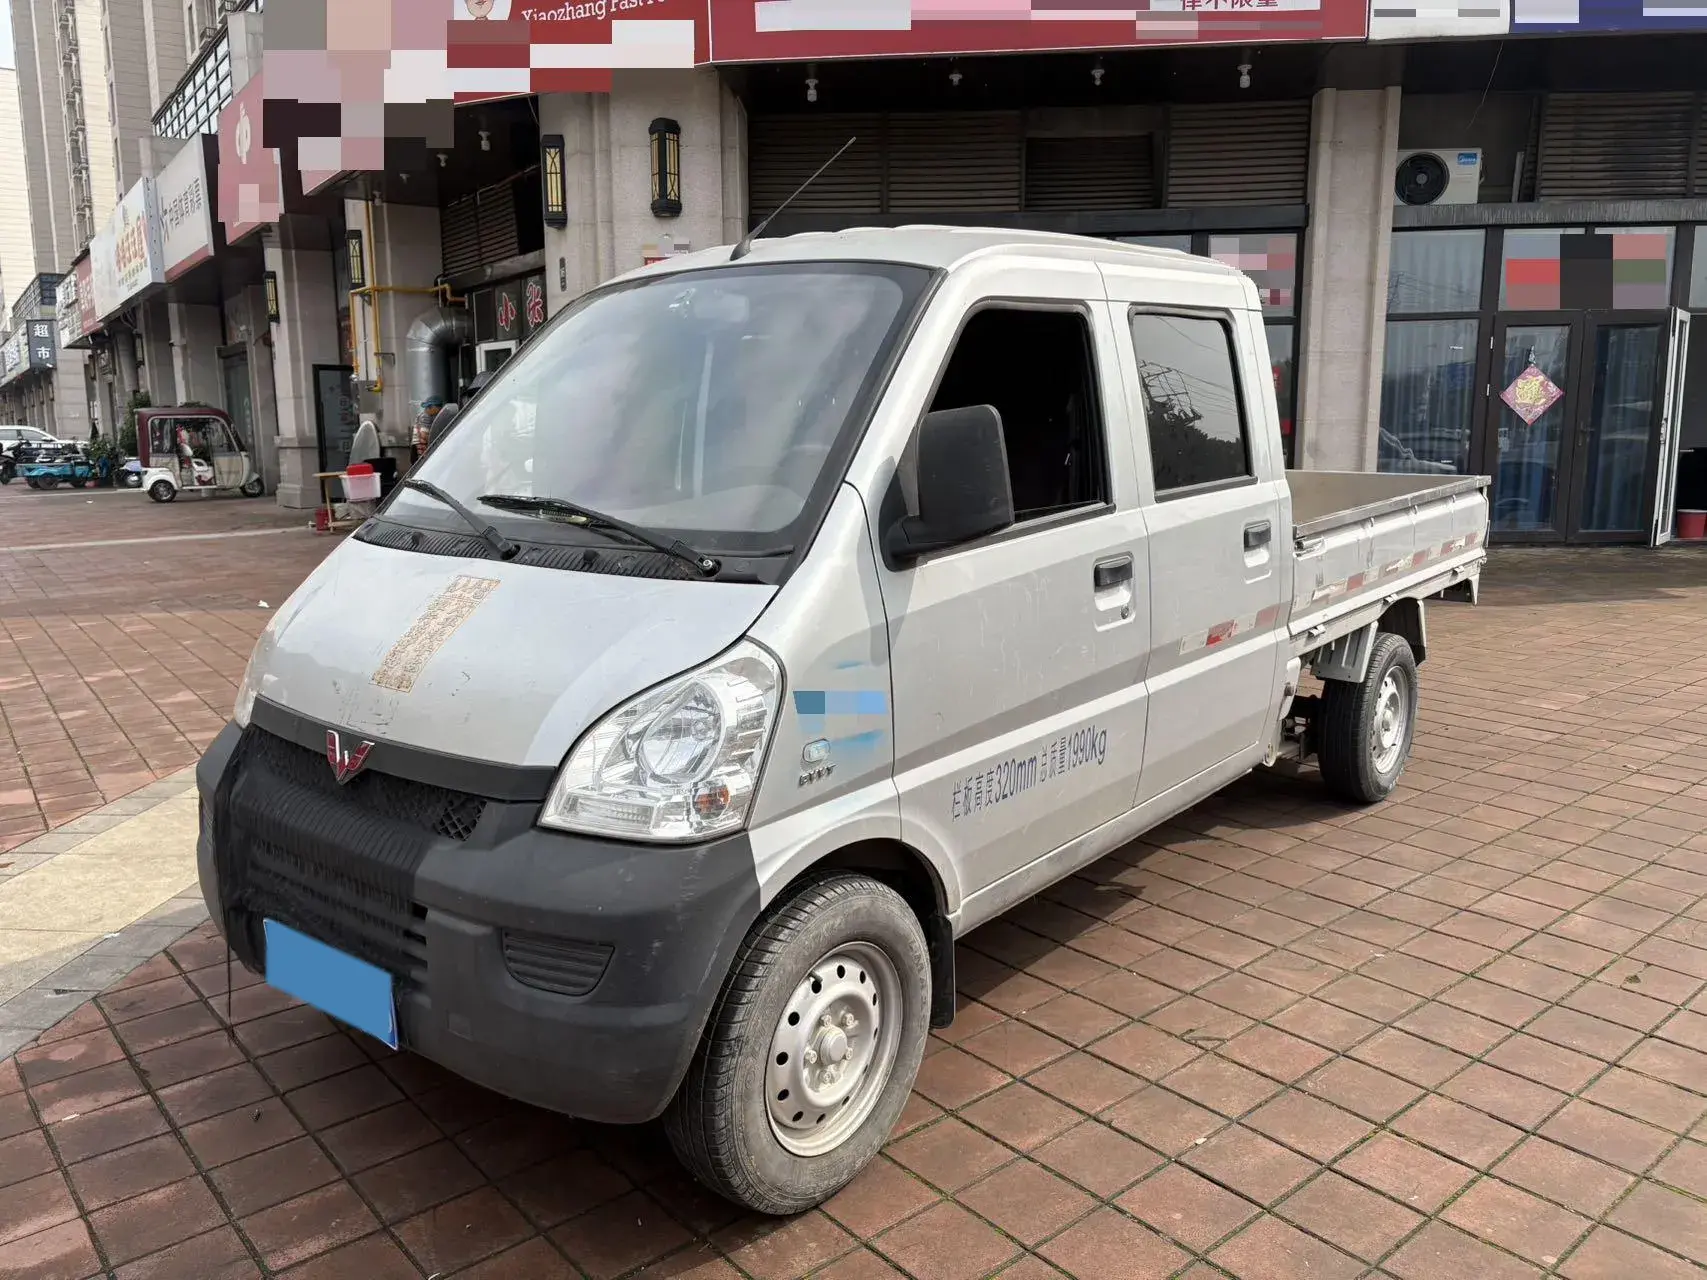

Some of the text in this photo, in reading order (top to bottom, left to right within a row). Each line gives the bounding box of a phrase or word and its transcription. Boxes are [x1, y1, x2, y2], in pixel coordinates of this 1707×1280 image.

[521, 0, 607, 20] Xiaozhang
[33, 323, 51, 360] 超市
[951, 724, 1108, 823] 栏板高度320mm 总质量1990kg
